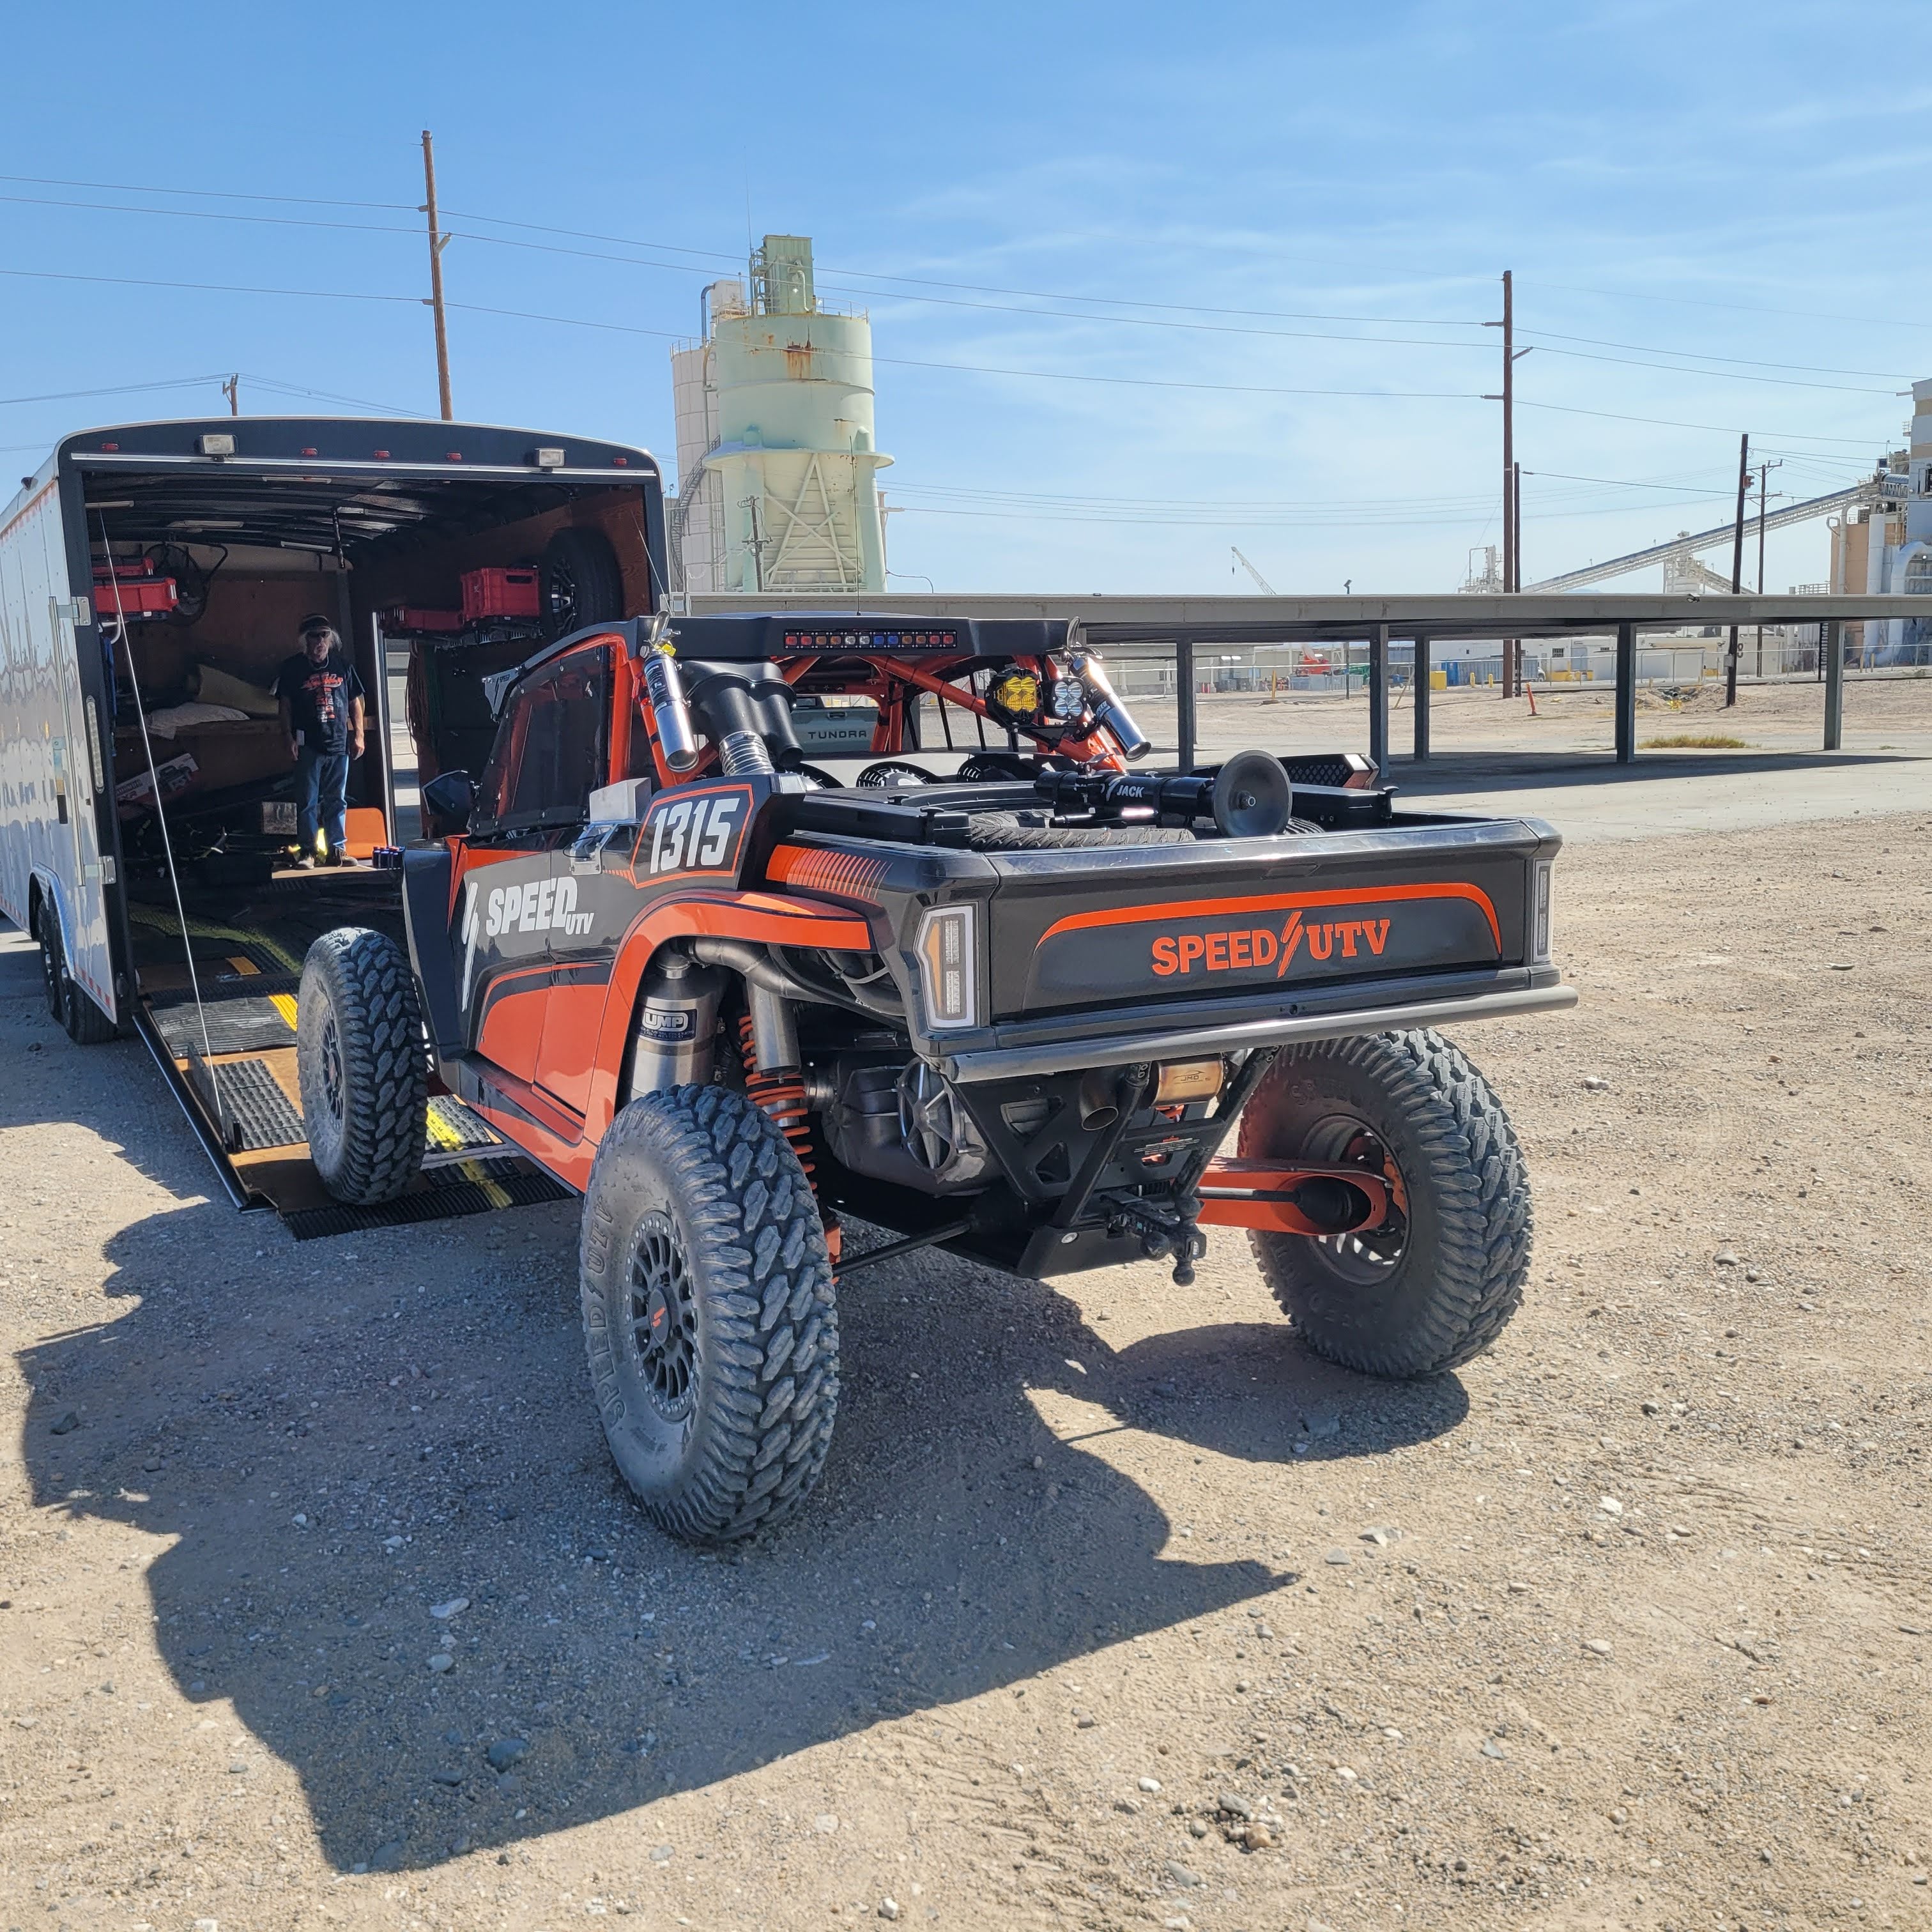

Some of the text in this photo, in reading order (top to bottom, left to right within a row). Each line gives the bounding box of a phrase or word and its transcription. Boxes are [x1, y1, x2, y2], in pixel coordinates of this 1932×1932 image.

[807, 730, 867, 740] TUNDRA
[1116, 785, 1145, 798] JACK
[650, 797, 740, 874] 1315
[486, 876, 595, 937] SPEED UTV
[1151, 919, 1390, 976] SPEED UTV
[645, 1011, 684, 1028] UMP
[587, 1195, 626, 1427] SPEED UTV
